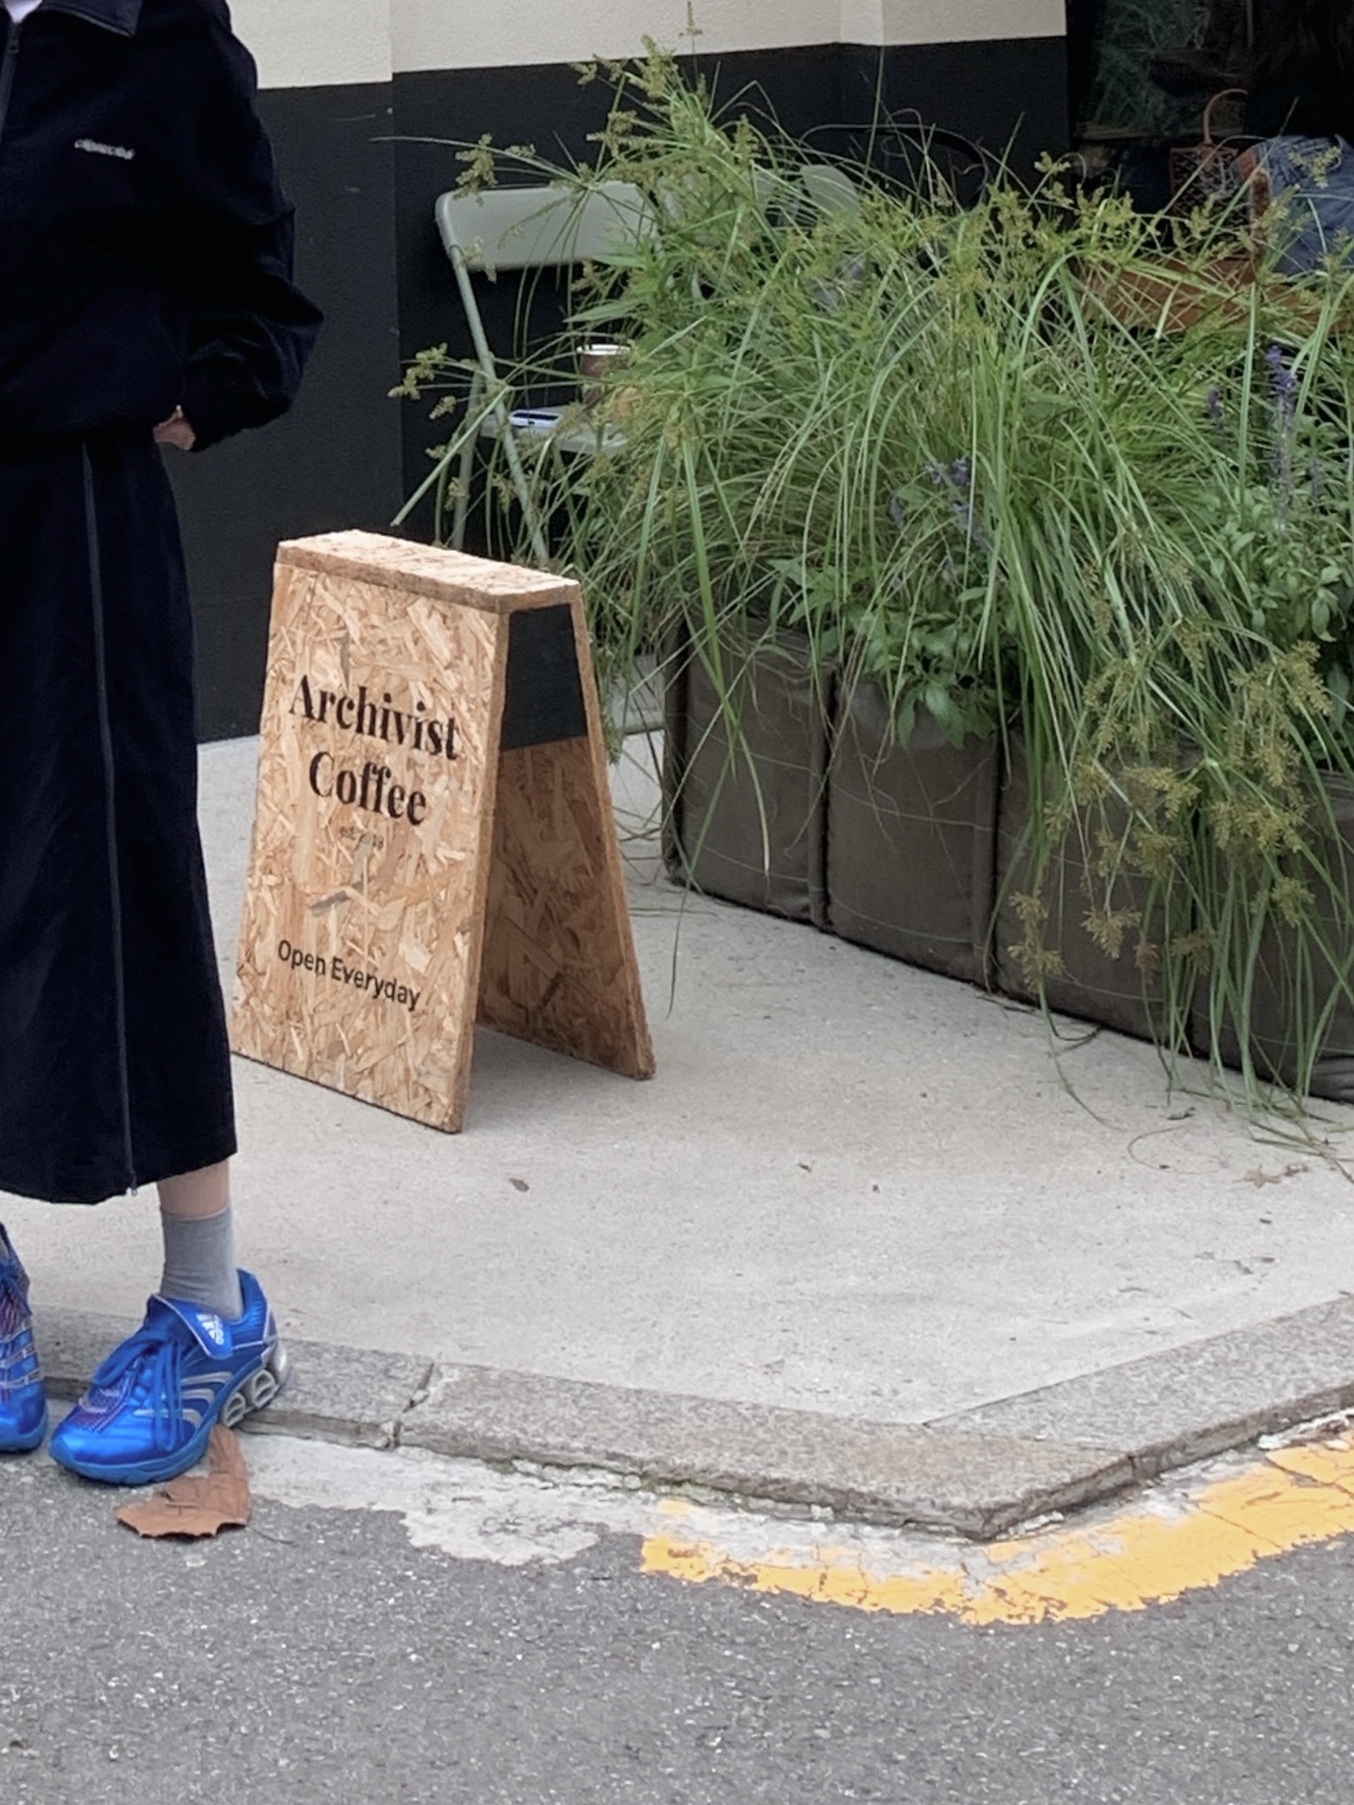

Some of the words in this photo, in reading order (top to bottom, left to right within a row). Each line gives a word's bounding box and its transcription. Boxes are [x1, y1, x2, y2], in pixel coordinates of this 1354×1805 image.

[289, 674, 460, 760] Archivist
[309, 751, 427, 825] Coffee
[278, 939, 326, 975] Open
[331, 956, 421, 1012] Everyday
